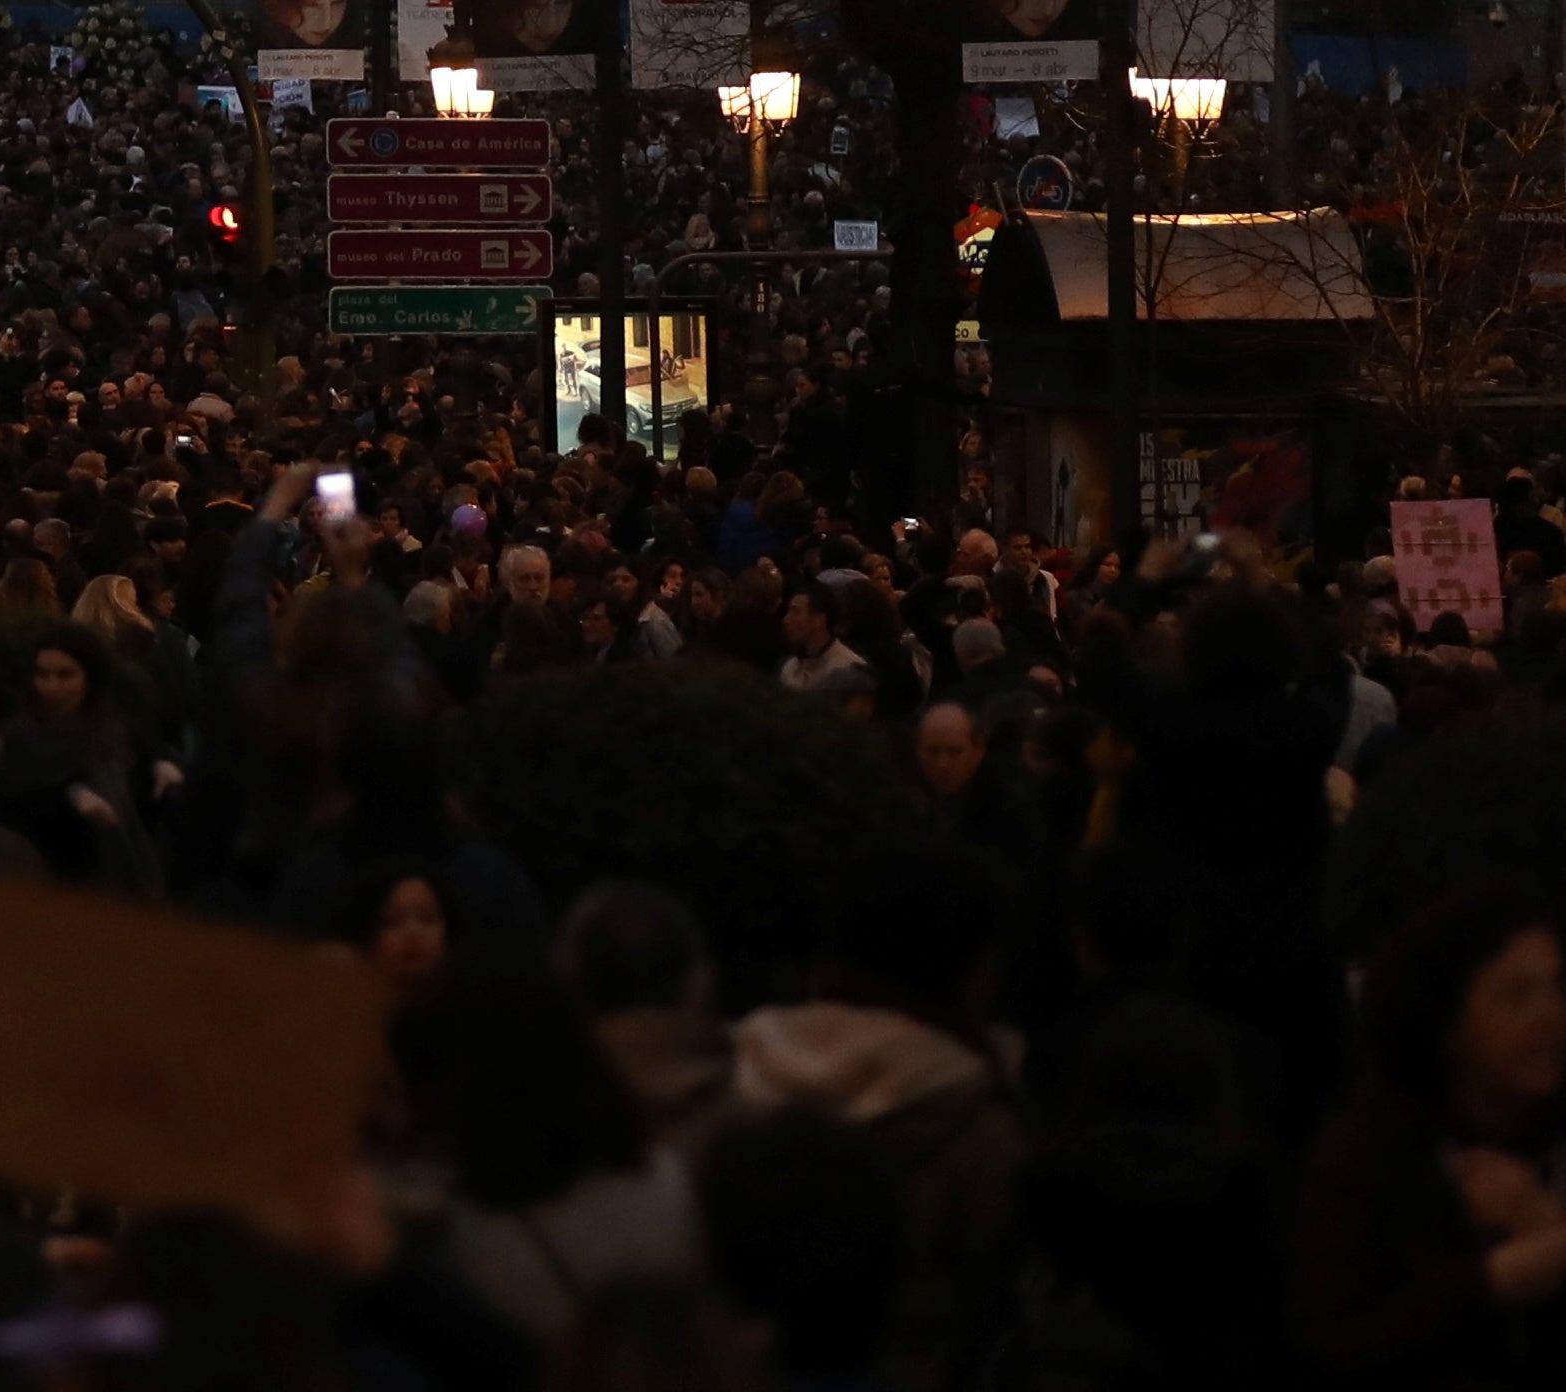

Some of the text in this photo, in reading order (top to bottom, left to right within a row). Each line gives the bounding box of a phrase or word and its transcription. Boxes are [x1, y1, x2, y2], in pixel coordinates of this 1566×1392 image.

[970, 65, 980, 78] 9
[981, 65, 1007, 78] mar
[1032, 64, 1042, 76] 8
[1045, 64, 1069, 76] abr
[405, 136, 542, 150] Casa de América
[336, 191, 459, 208] museo Thyssen
[336, 247, 463, 262] museo del Prado
[379, 293, 399, 304] del
[394, 310, 451, 324] Carlos
[1139, 432, 1156, 457] 15
